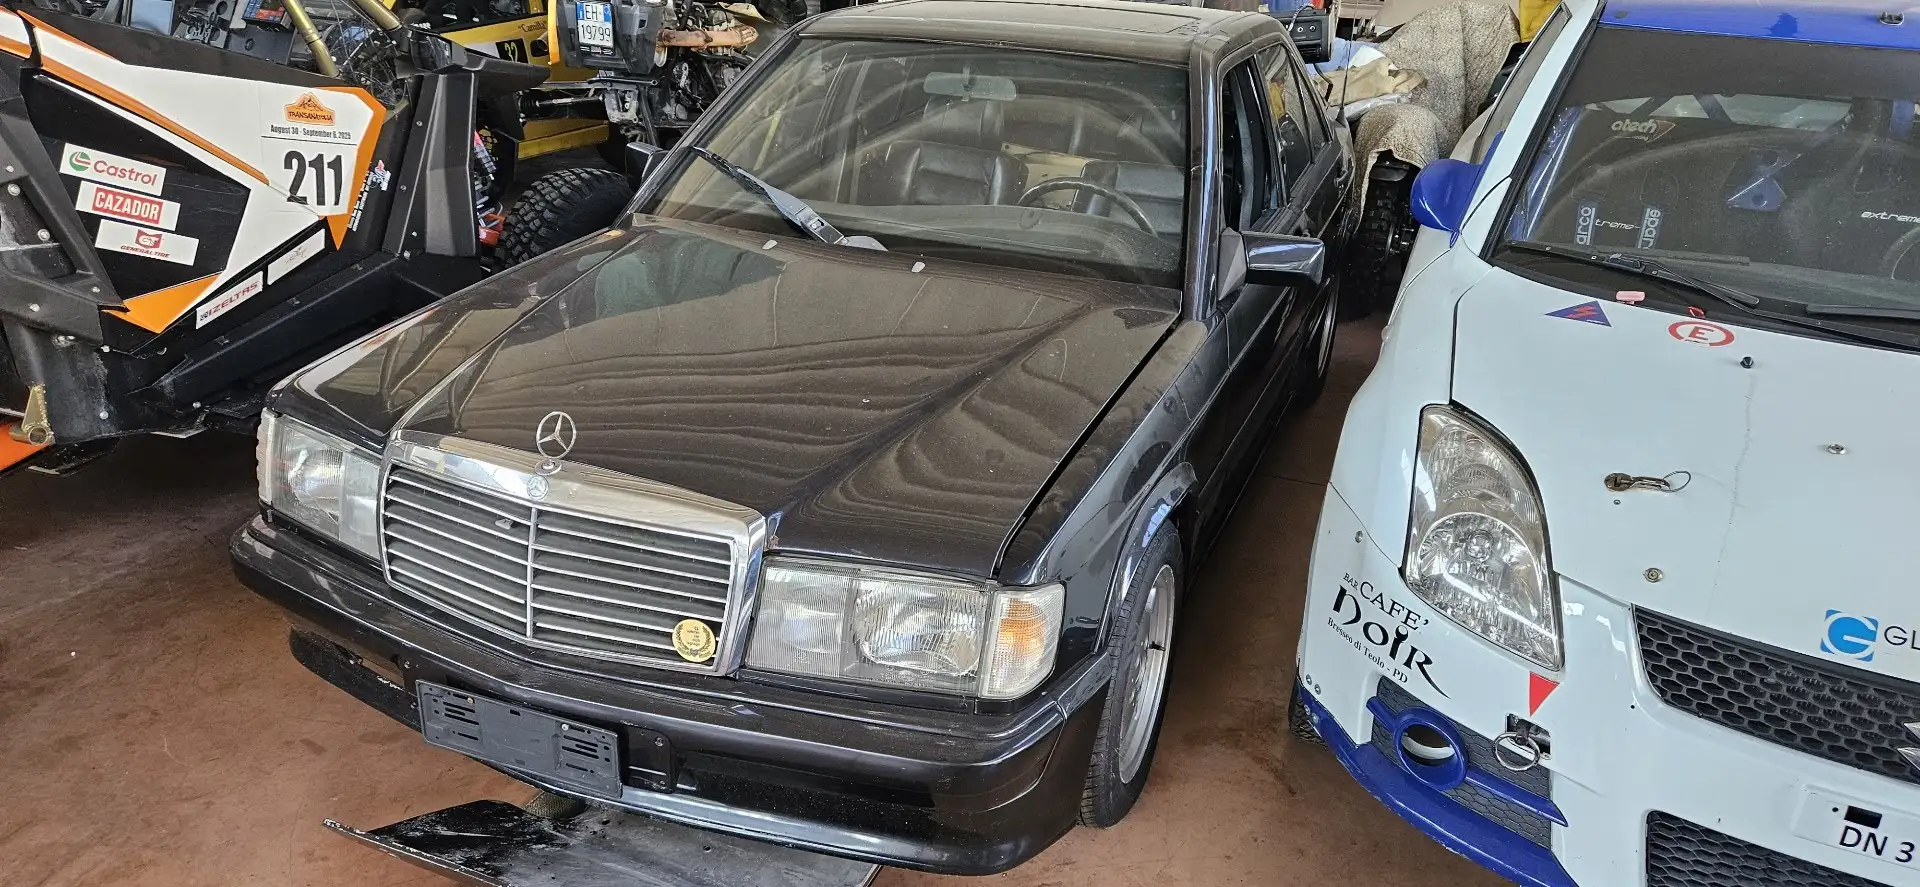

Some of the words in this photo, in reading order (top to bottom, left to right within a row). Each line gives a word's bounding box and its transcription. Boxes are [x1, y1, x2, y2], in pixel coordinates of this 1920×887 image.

[585, 4, 598, 20] EH
[581, 24, 612, 43] 19799
[270, 124, 291, 135] August
[291, 126, 299, 135] 30
[302, 128, 332, 138] September
[338, 131, 352, 140] 2025
[93, 160, 158, 186] Castrol
[283, 150, 343, 206] 211
[94, 191, 161, 221] CAZADOR
[1576, 206, 1593, 246] arco
[1642, 208, 1661, 250] spar
[120, 245, 154, 256] GENERAL
[153, 251, 171, 259] TIRE
[1688, 325, 1715, 341] E
[1342, 572, 1359, 590] BAR
[1327, 617, 1353, 644] Bresseo
[1353, 640, 1362, 651] di
[1363, 645, 1385, 669] Teolo
[1392, 667, 1409, 684] PD
[1839, 825, 1888, 856] DN
[1894, 841, 1915, 863] 3
